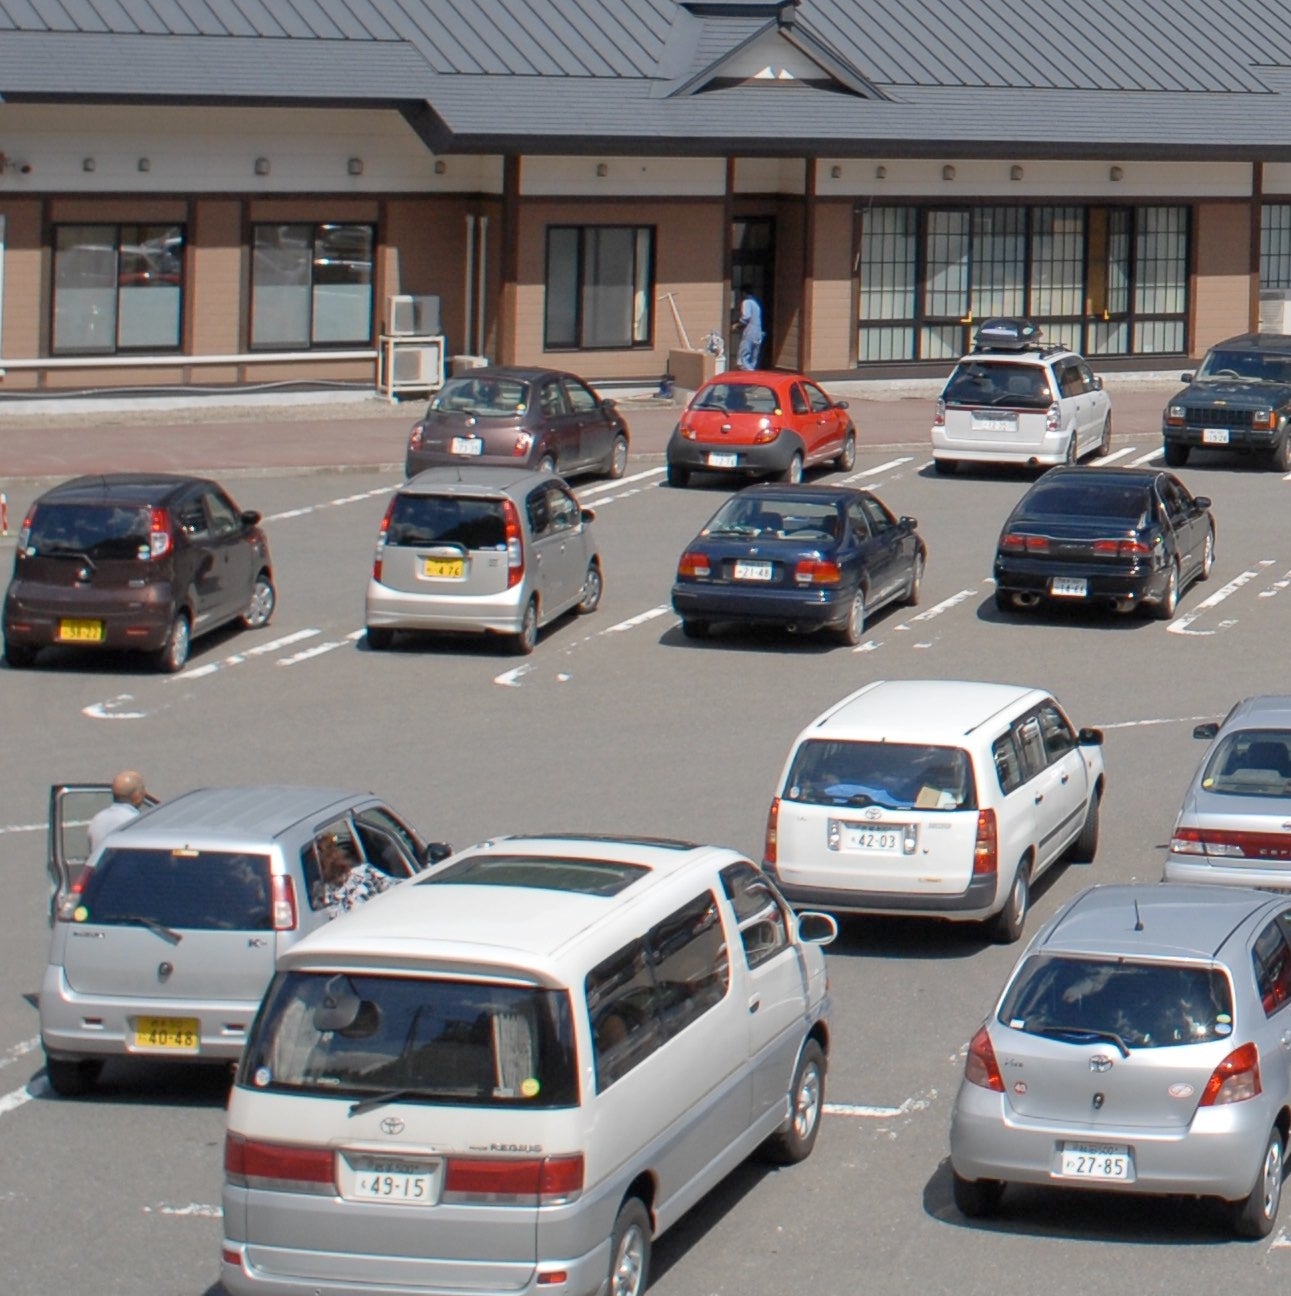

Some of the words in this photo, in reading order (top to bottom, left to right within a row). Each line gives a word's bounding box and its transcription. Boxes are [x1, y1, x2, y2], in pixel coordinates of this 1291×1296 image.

[859, 834, 896, 848] 42-03
[1077, 1157, 1124, 1176] 27-85
[370, 1175, 424, 1197] 49-15
